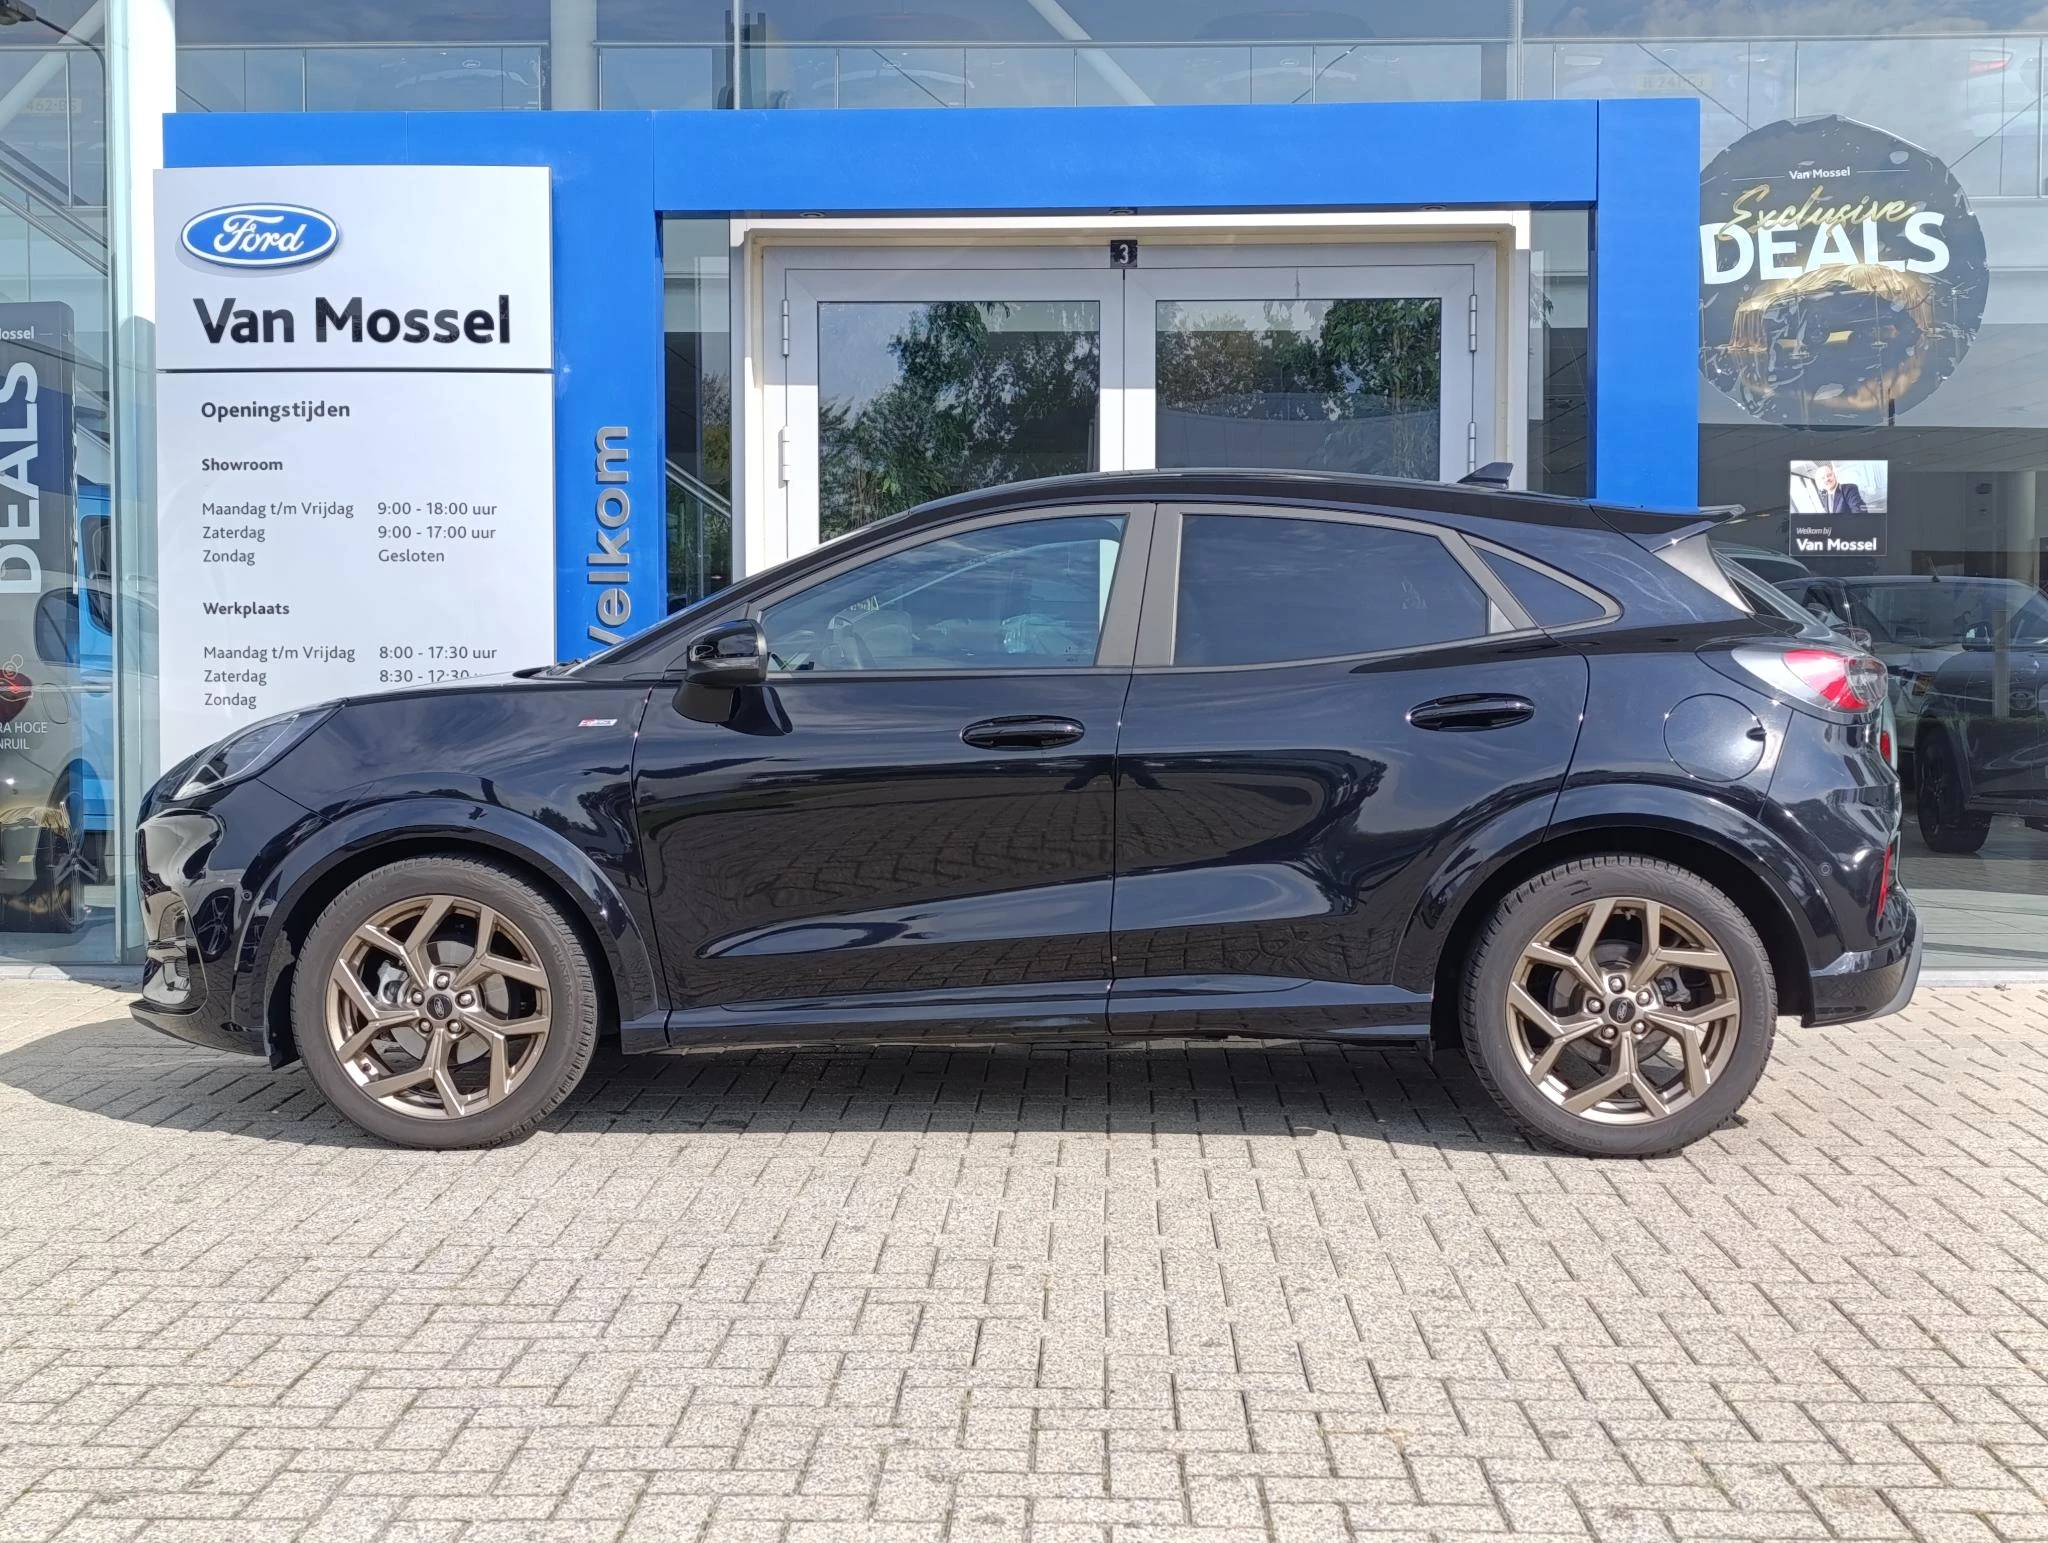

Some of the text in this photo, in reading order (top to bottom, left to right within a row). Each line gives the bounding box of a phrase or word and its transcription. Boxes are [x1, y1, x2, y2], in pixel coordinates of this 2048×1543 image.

[1789, 167, 1851, 180] Van Mossel
[1718, 184, 1916, 241] Exclusive
[213, 214, 307, 253] Ford
[1120, 244, 1129, 264] 3
[1700, 211, 1950, 285] DEALS
[193, 295, 509, 343] Van Mossel
[0, 326, 35, 340] ossel
[202, 401, 350, 423] Openingstijden
[202, 458, 283, 472] Showroom
[0, 362, 42, 593] DEALS
[203, 502, 354, 519] Maandag t/m Vrijdag
[378, 503, 412, 515] 9:00
[427, 503, 468, 515] 18:00
[473, 506, 498, 516] uur
[203, 526, 266, 543] Zaterdag
[378, 526, 412, 539] 9:00
[427, 526, 467, 539] 17:00
[472, 530, 497, 539] uur
[1796, 537, 1877, 551] Van Mossel
[203, 549, 256, 567] Zondag
[379, 549, 445, 563] Gesloten
[203, 602, 290, 619] Werkplaats
[204, 646, 356, 663] Maandag t/m Vrijdag
[380, 647, 414, 659] 8:00
[428, 646, 468, 659] 17:30
[473, 650, 497, 659] uur
[204, 669, 268, 687] Zaterdag
[380, 670, 413, 683] 8:30
[205, 693, 257, 710] Zondag
[14, 721, 48, 734] HOGE
